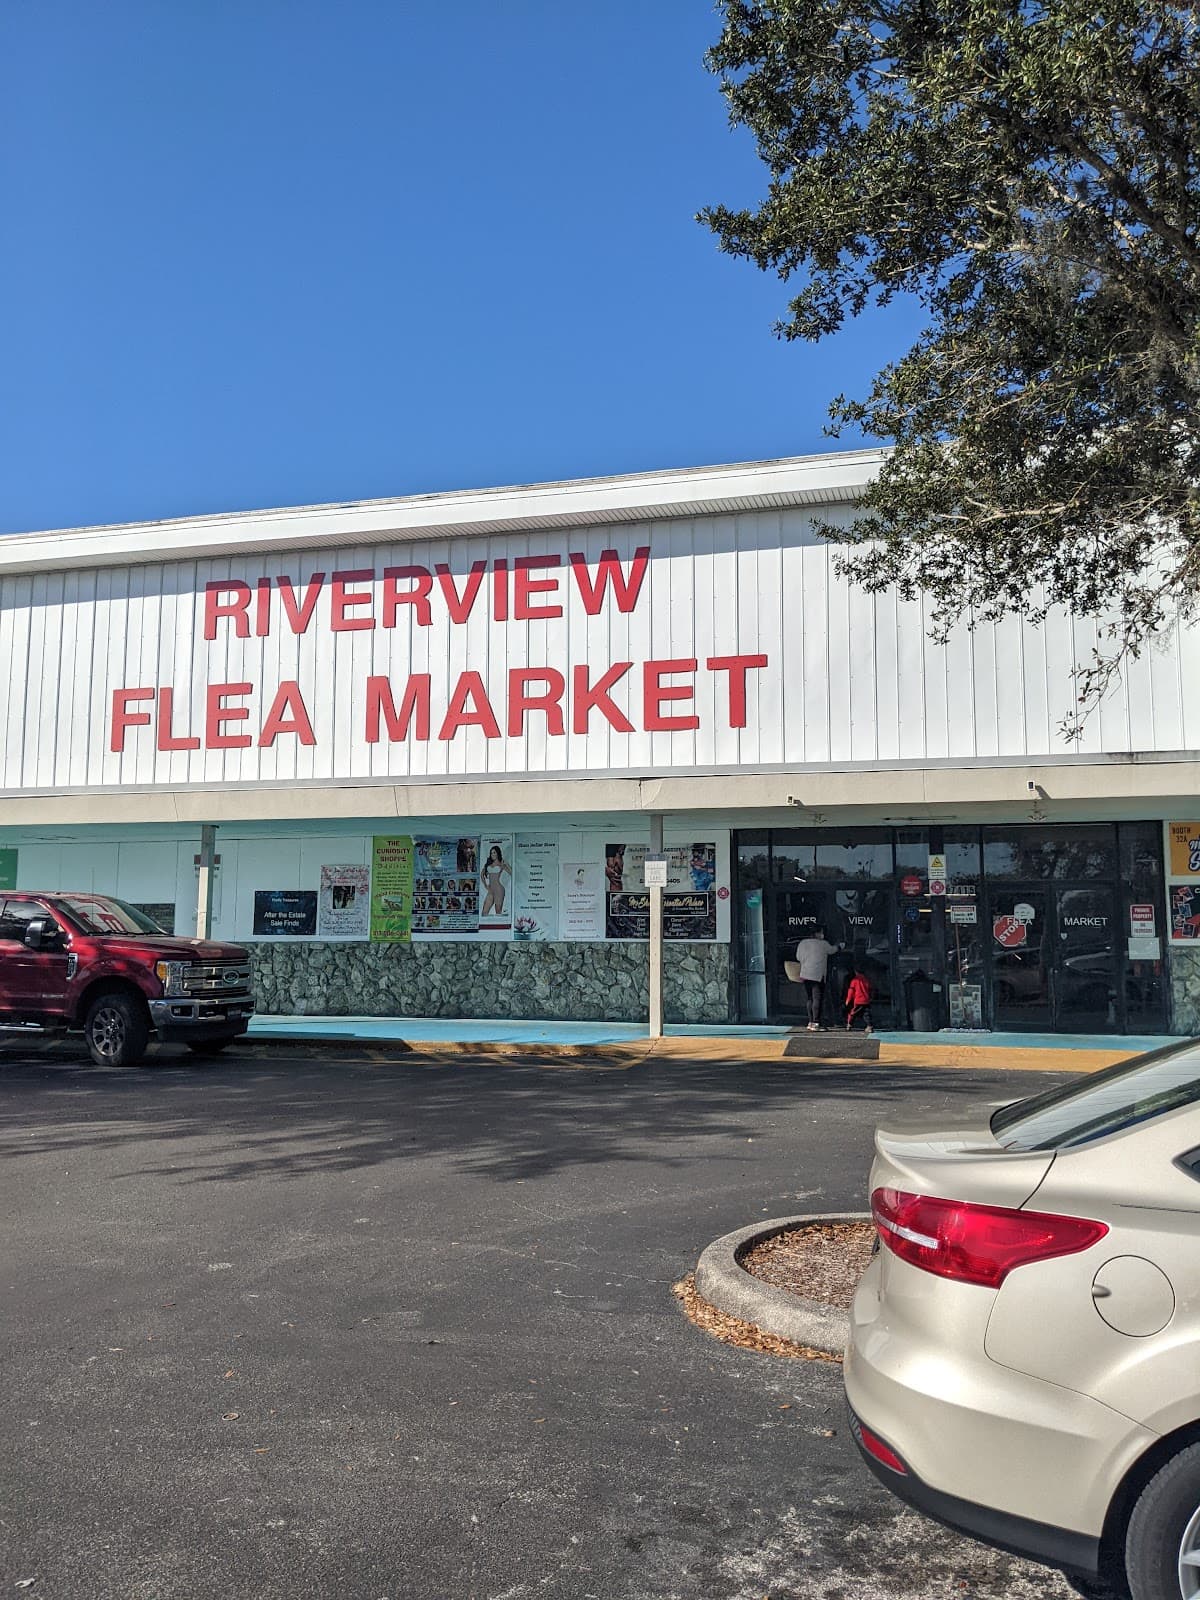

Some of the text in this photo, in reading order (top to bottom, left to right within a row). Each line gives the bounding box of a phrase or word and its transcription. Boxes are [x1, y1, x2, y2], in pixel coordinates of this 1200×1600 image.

[204, 546, 650, 640] RIVERVIEW
[110, 654, 768, 752] FLEA MARKET
[264, 911, 307, 919] After the Estate
[270, 919, 300, 927] Sale Finds
[848, 916, 873, 925] VIEW
[1064, 917, 1108, 926] MARKET
[998, 919, 1019, 942] STOP
